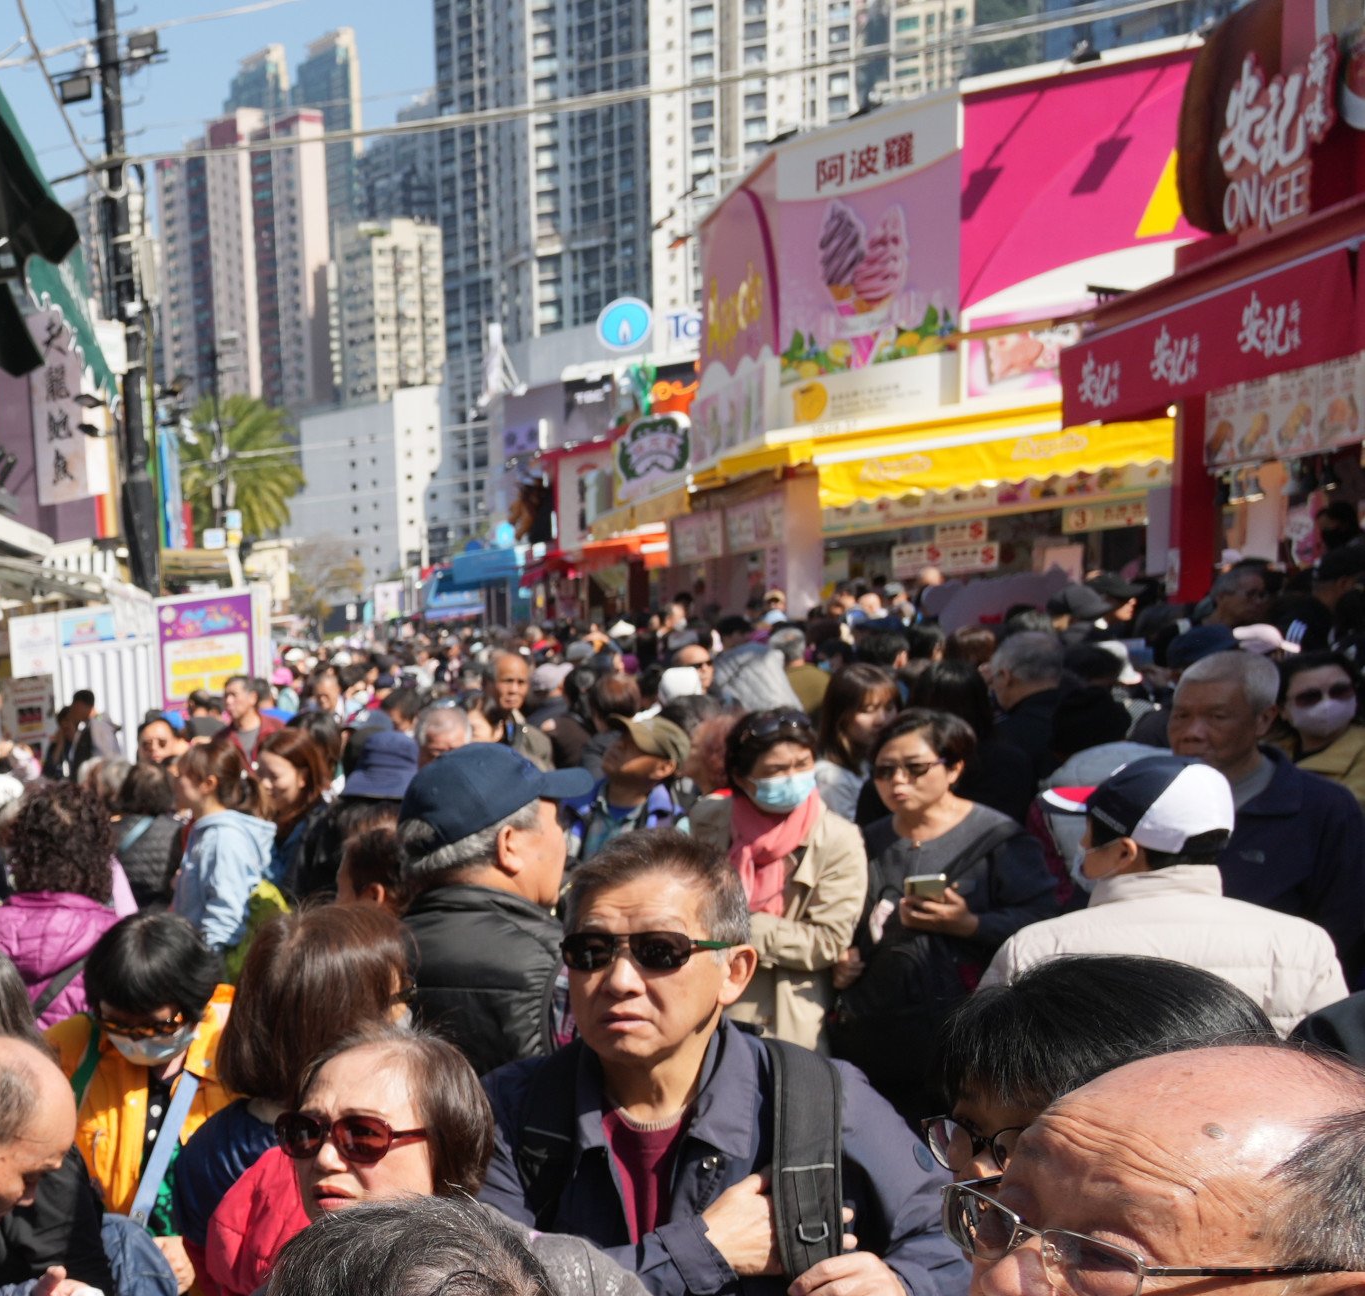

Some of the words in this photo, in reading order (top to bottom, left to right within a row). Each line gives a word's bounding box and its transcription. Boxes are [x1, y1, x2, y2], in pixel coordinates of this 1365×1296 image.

[1218, 57, 1306, 176] 安記
[816, 133, 915, 191] 阿波羅
[1223, 173, 1259, 233] ON
[1259, 164, 1307, 232] KEE
[1237, 291, 1290, 358] 安記
